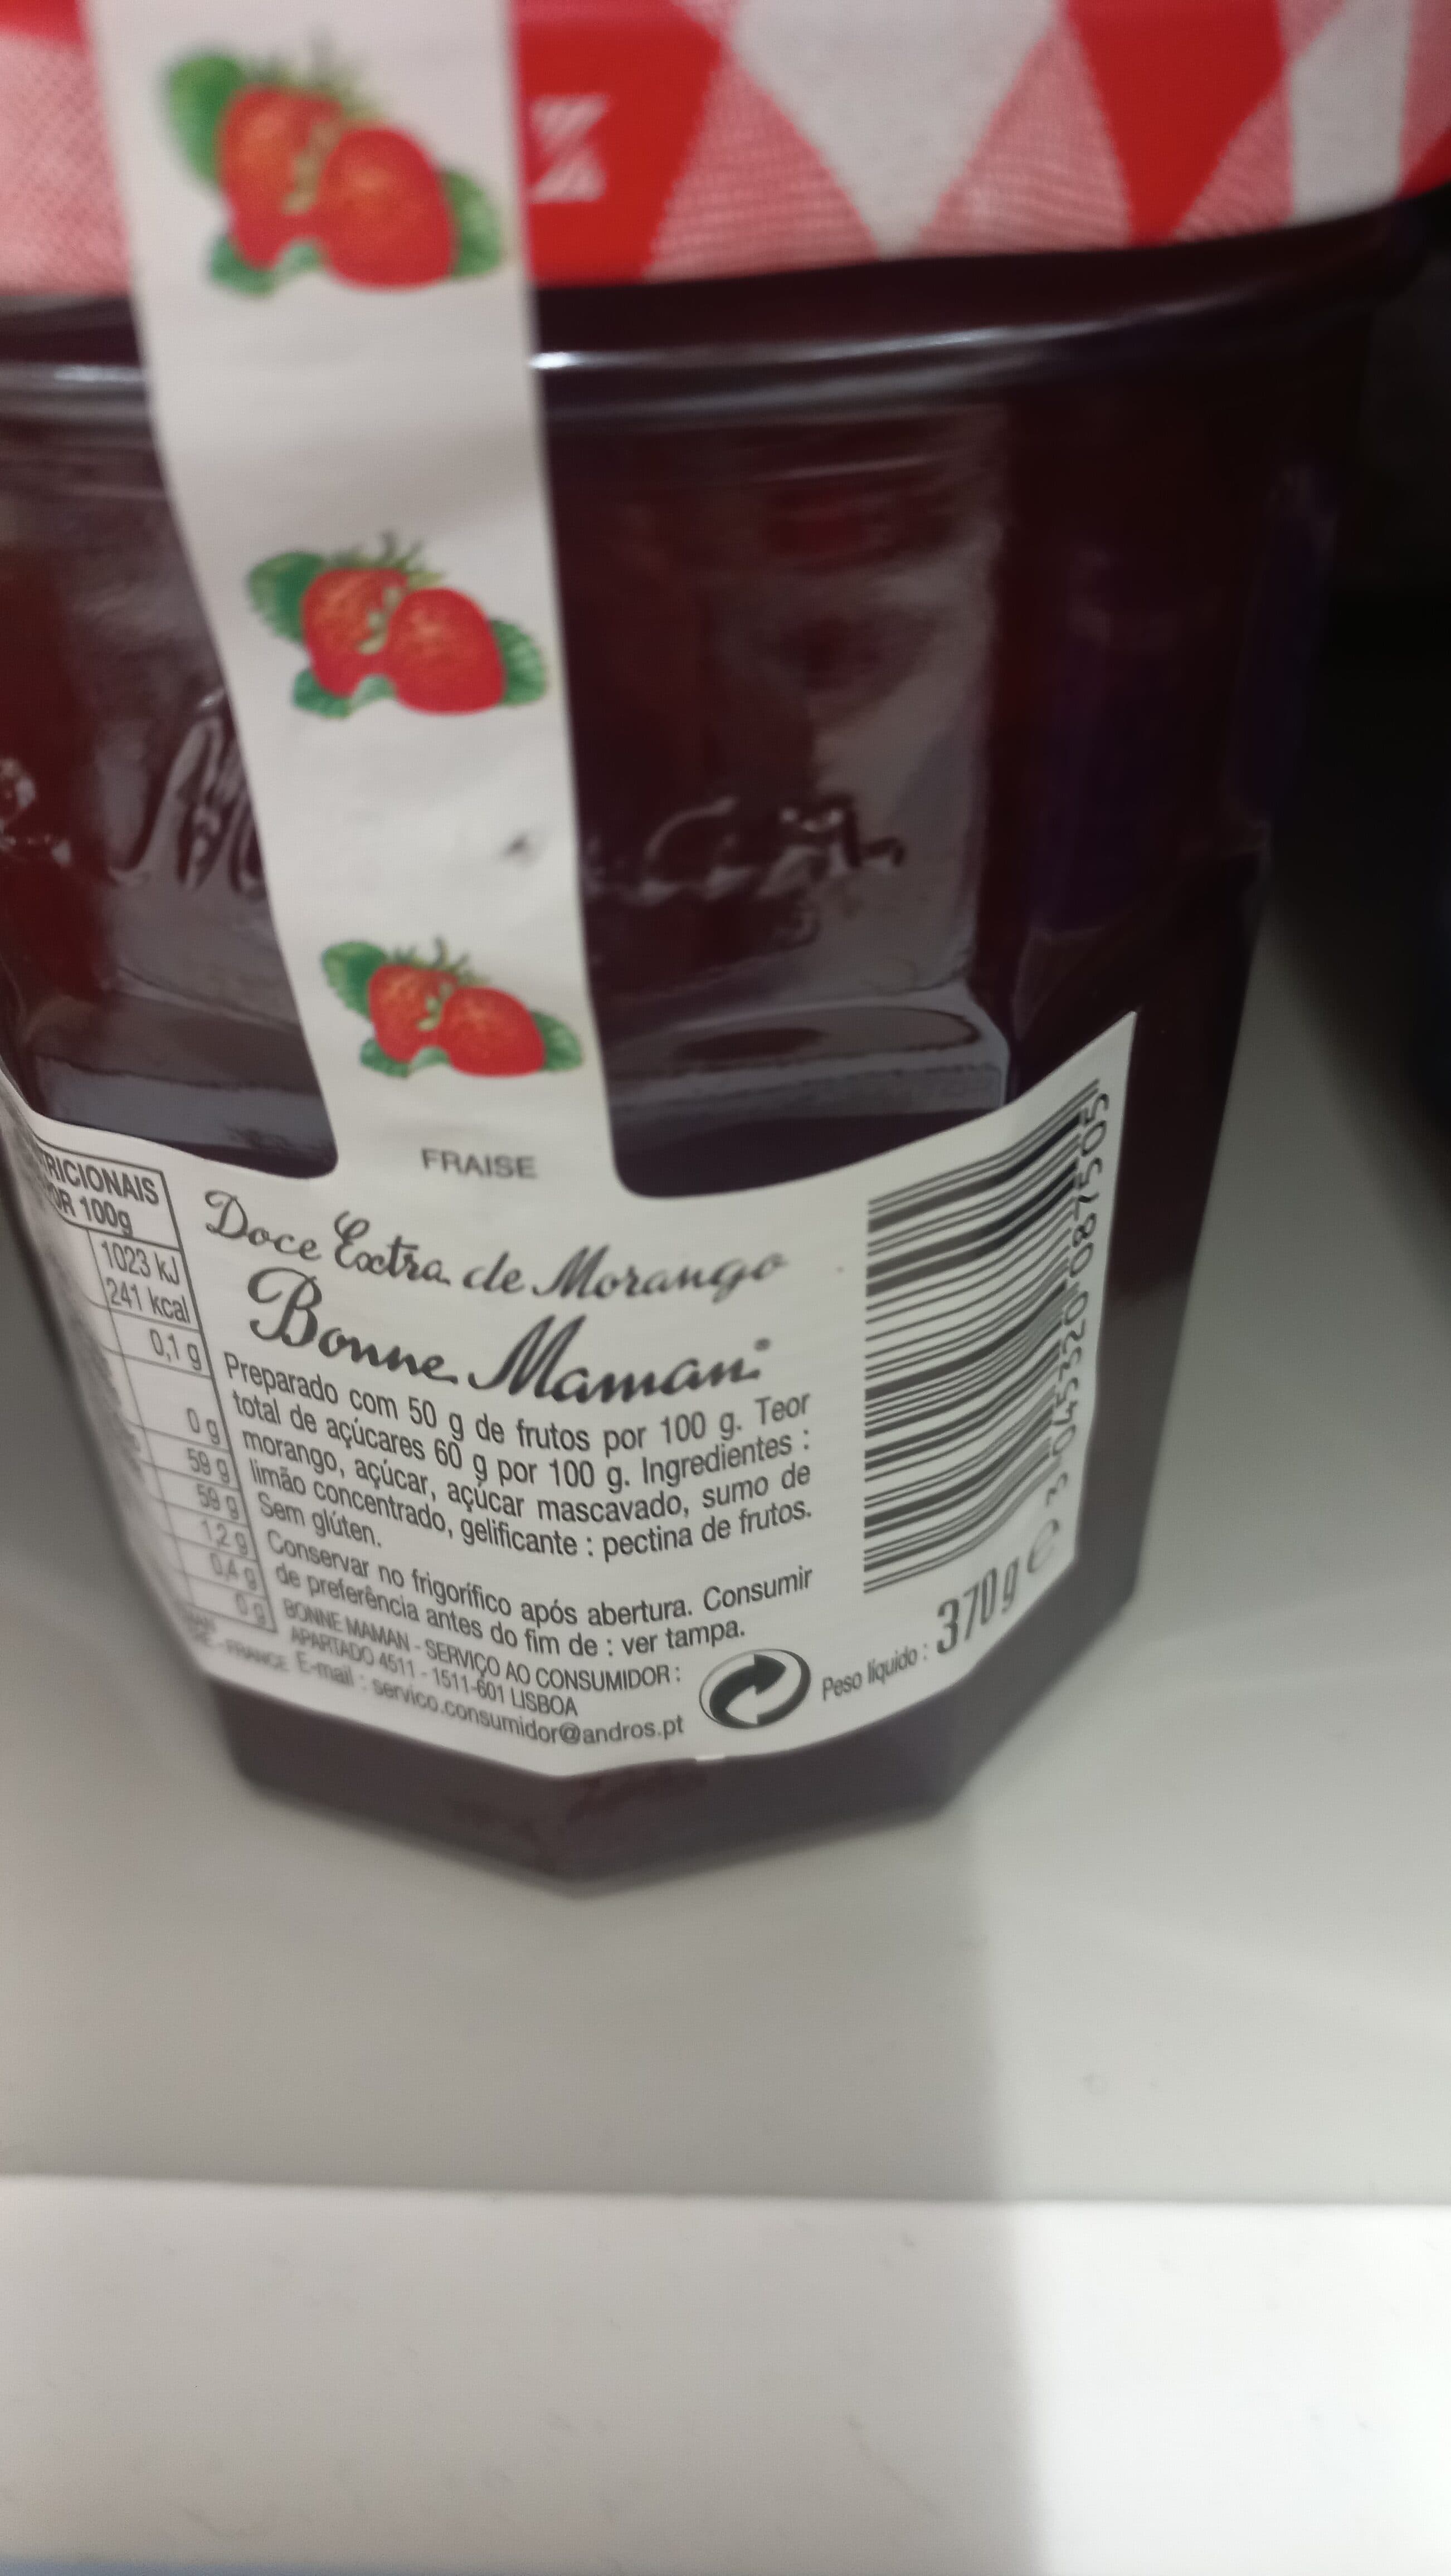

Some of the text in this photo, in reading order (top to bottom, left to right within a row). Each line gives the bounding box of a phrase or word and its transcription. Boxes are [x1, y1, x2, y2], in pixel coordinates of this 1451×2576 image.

[43, 1150, 159, 1206] RICIONAIS
[422, 1148, 537, 1180] FRAISE
[79, 1196, 133, 1237] 100g
[101, 1241, 180, 1285] 1023 kJ
[205, 1189, 788, 1304] Doce Extra de Morango
[106, 1277, 191, 1324] 241 kcal
[248, 1267, 457, 1384] Bonne
[150, 1329, 202, 1370] 0,1 g
[187, 1408, 220, 1445] 0 g
[224, 1352, 811, 1458] Preparado com 50 g de frutos por 100 g. Teor
[187, 1448, 230, 1484] 59 g
[232, 1389, 281, 1426] total
[290, 1404, 317, 1433] de
[327, 1417, 426, 1460] açúcares
[435, 1438, 462, 1469] 60
[474, 1454, 488, 1482] g
[498, 1458, 538, 1486] por
[549, 1458, 595, 1488] 100
[607, 1465, 631, 1494] g.
[642, 1433, 792, 1487] Ingredientes
[197, 1484, 239, 1520] 59 g
[242, 1430, 811, 1523] morango, açúcar, açúcar mascavado, sumo de
[250, 1457, 306, 1496] limão
[314, 1480, 453, 1539] concentrado,
[460, 1518, 578, 1556] gelificante
[603, 1525, 693, 1563] pectina
[702, 1515, 732, 1544] de
[738, 1499, 812, 1535] frutos.
[257, 1491, 382, 1547] Sem glúten.
[267, 1529, 813, 1628] Conservar no frigorífico após abertura. Consumir
[276, 1563, 301, 1588] de
[307, 1574, 420, 1622] preferência
[426, 1608, 483, 1639] antes
[490, 1621, 518, 1647] do
[524, 1627, 559, 1656] fim
[568, 1634, 598, 1657] de
[621, 1633, 659, 1656] ver
[668, 1619, 746, 1650] tampa.
[283, 1597, 343, 1633] BONNE
[345, 1616, 410, 1652] MAMAN
[425, 1638, 500, 1678] SERVIÇO
[506, 1661, 530, 1685] AO
[536, 1663, 670, 1692] CONSUMIDOR
[291, 1626, 375, 1666] APARTADO
[379, 1652, 415, 1678] 4511
[432, 1667, 504, 1704] 1511-601
[511, 1686, 578, 1718] LISBOA
[295, 1650, 354, 1687] E-mail
[822, 1671, 863, 1702] Peso
[867, 1645, 918, 1685] líquido
